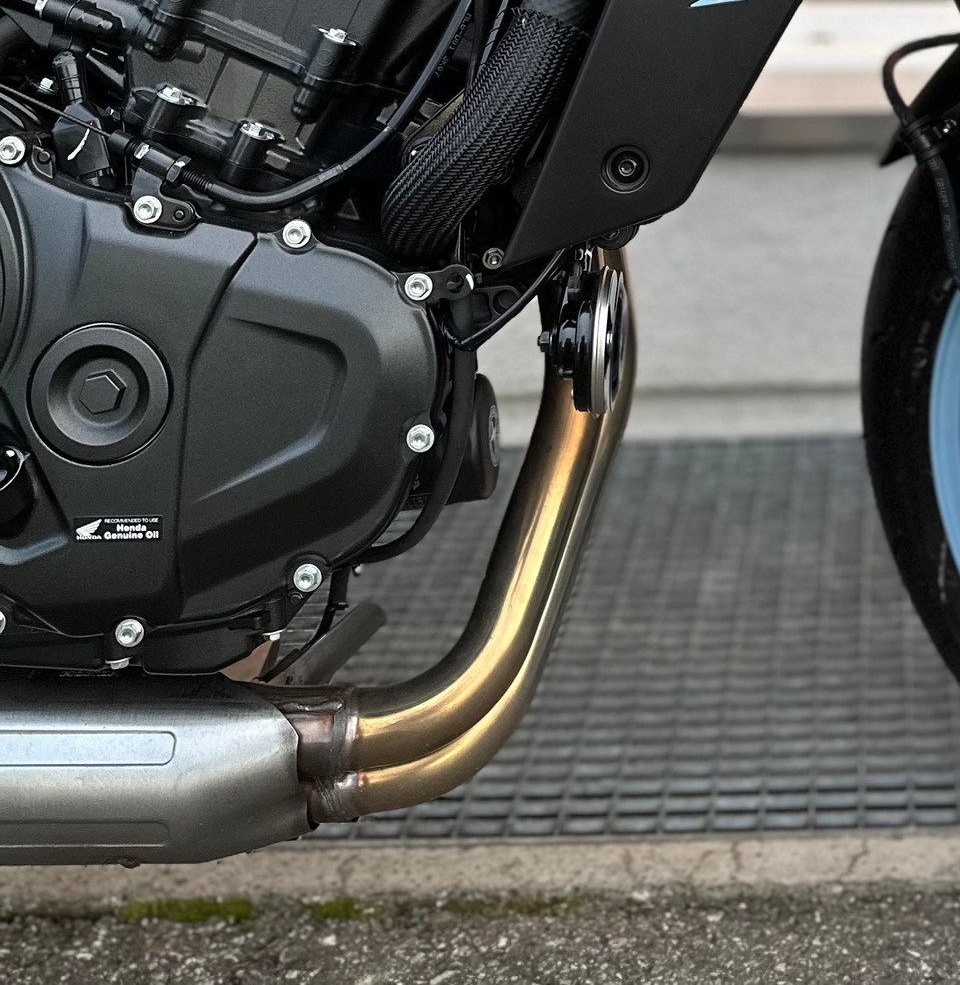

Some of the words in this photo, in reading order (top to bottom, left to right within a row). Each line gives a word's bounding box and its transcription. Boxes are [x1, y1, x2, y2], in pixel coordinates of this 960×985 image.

[116, 524, 147, 532] Honda
[104, 531, 143, 540] Genuine
[145, 530, 159, 539] Oil
